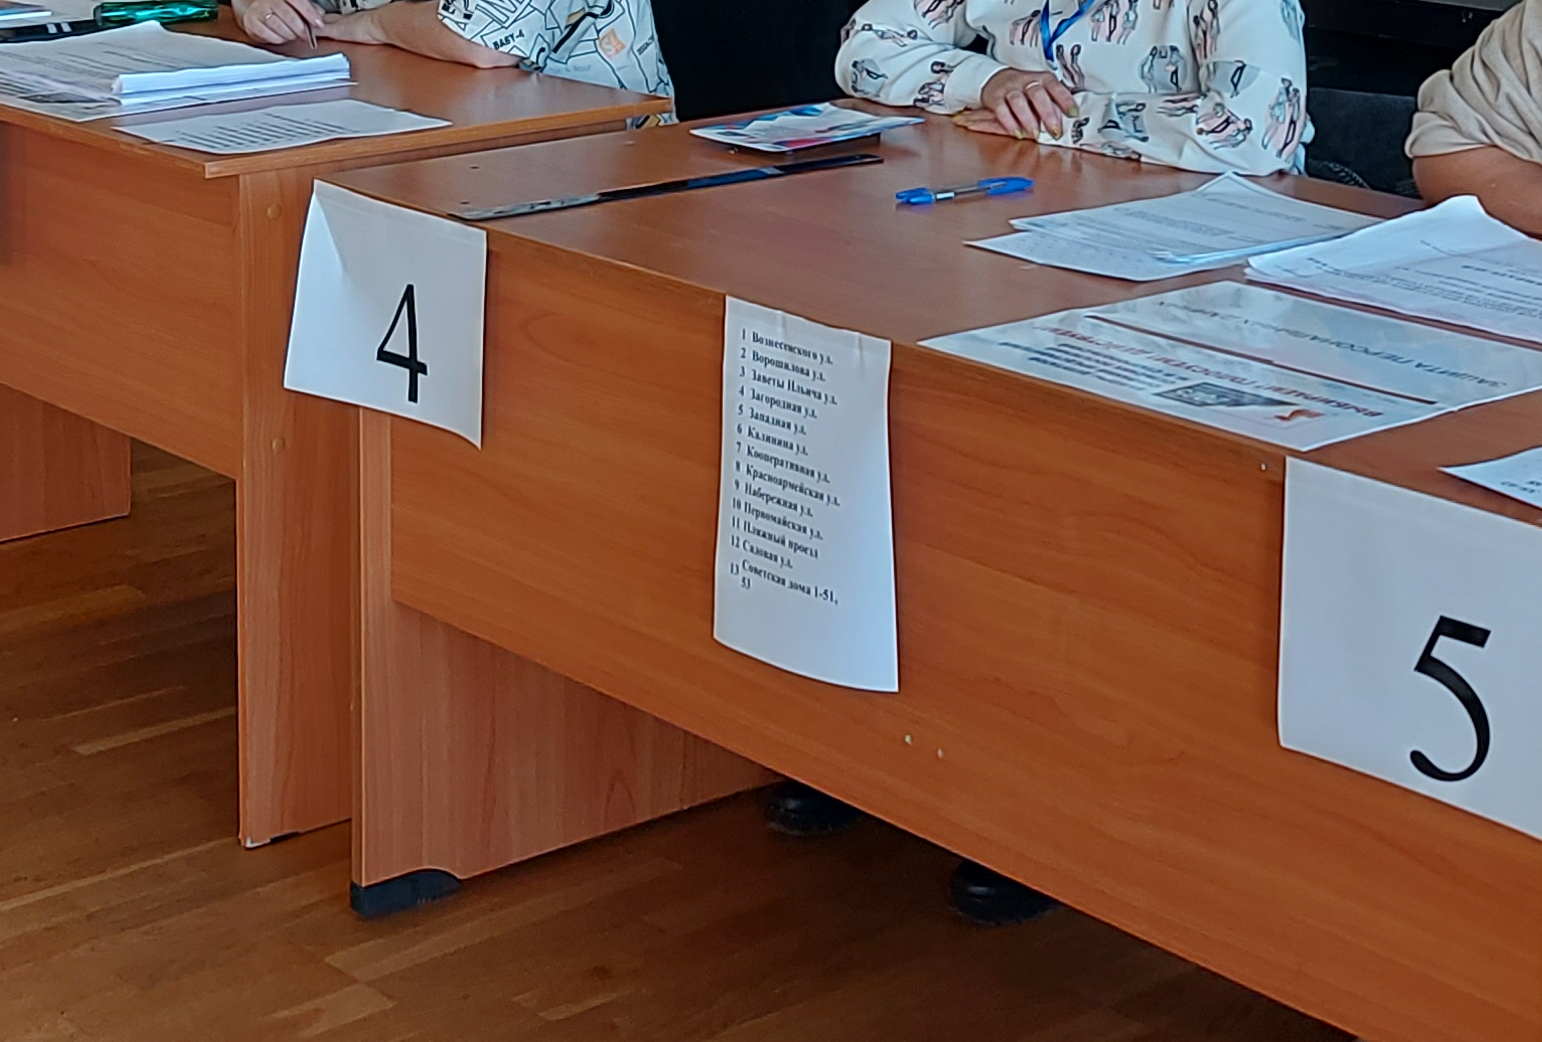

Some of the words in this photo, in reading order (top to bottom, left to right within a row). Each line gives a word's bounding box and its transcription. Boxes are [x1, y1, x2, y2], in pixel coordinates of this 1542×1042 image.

[376, 284, 428, 404] 4
[752, 331, 818, 360] Вознесенского
[752, 350, 810, 377] Ворошилова
[751, 369, 784, 389] Заветы
[787, 379, 822, 400] Ильича
[750, 388, 802, 414] Загородная
[750, 407, 791, 430] Западная
[748, 425, 794, 451] Калинина
[747, 445, 815, 478] Кооперативная
[745, 482, 798, 512] Набережная
[746, 464, 824, 501] Красноармейская
[732, 497, 741, 510] 10
[744, 501, 807, 534] Первомайская
[731, 534, 740, 548] 12
[742, 539, 778, 563] Садовая
[730, 562, 739, 575] 13
[742, 559, 786, 586] Советская
[787, 580, 811, 595] дома
[1410, 615, 1491, 782] 5
